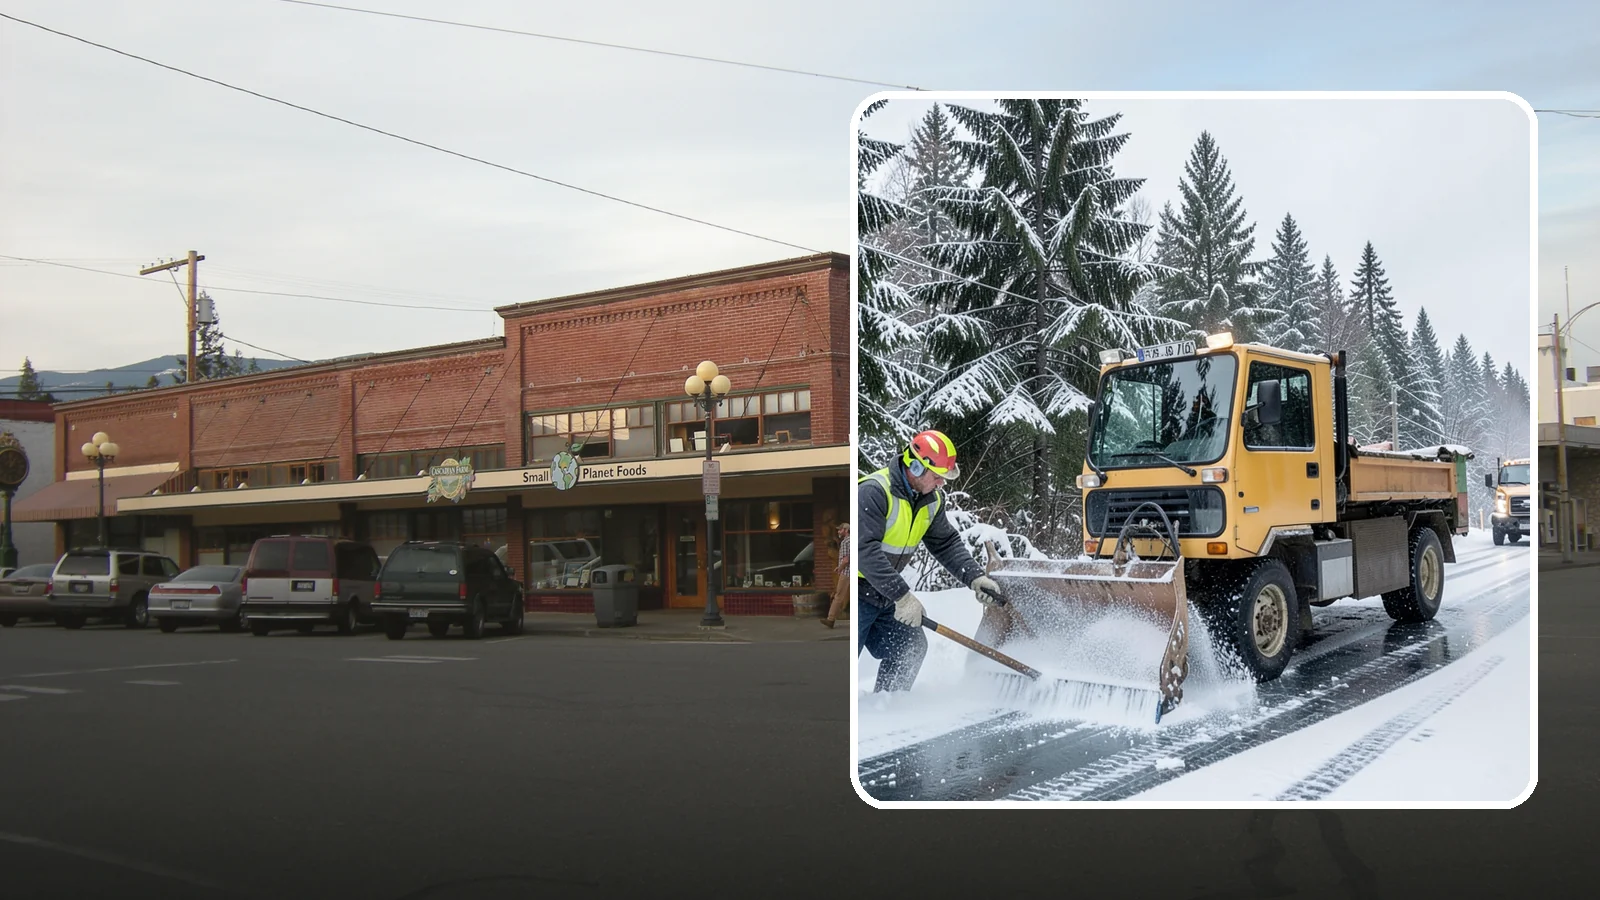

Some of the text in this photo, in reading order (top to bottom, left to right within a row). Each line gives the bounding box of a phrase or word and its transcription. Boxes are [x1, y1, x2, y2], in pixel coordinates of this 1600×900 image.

[523, 464, 646, 482] Small Planet Foods
